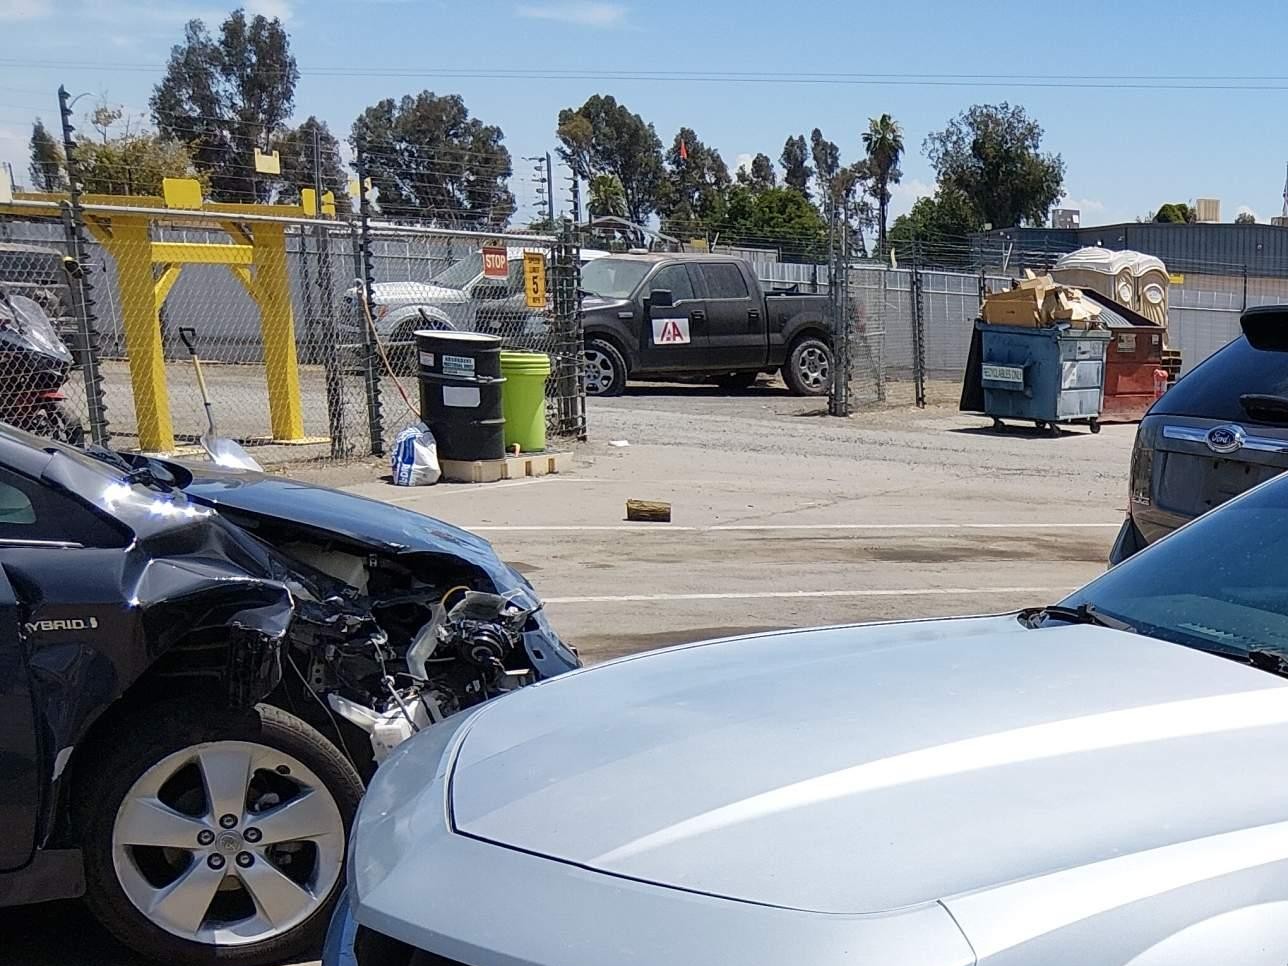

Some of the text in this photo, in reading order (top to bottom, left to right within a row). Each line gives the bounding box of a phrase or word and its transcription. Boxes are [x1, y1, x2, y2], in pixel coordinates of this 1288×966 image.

[486, 254, 506, 269] STOP
[532, 275, 539, 294] 5
[1211, 430, 1231, 443] Ford
